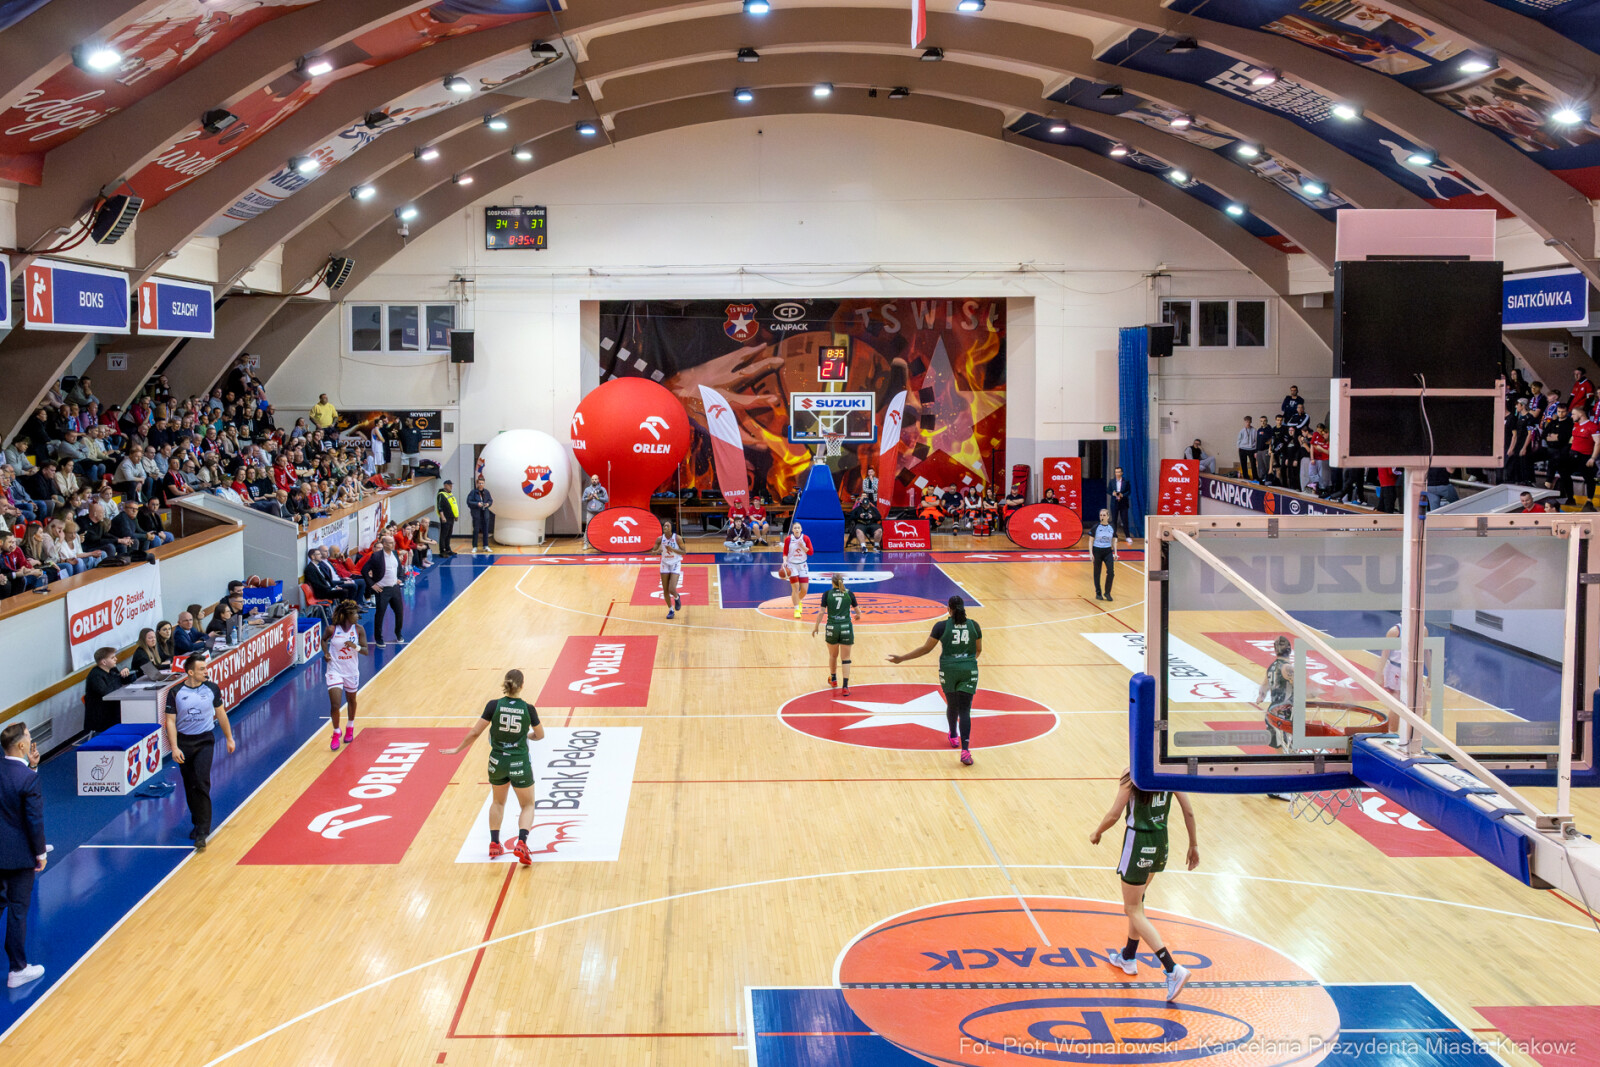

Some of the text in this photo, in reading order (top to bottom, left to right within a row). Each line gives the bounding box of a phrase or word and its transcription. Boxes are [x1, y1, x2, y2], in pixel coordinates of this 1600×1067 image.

[496, 219, 544, 229] 34 3 37
[489, 235, 496, 245] 0
[537, 235, 544, 245] 0
[79, 291, 104, 309] BOKS
[1507, 290, 1573, 309] SIATKÓWKA
[172, 301, 199, 317] SZACHY
[770, 323, 808, 331] CANPACK
[826, 349, 845, 358] 8:35
[821, 361, 845, 377] 21
[816, 399, 866, 408] SUZUKI
[633, 443, 671, 454] ORLEN
[1209, 479, 1253, 509] CANPACK
[609, 536, 641, 544] ORLEN
[1031, 532, 1062, 541] ORLEN
[126, 590, 145, 605] Basket
[835, 598, 843, 610] 7
[126, 607, 138, 620] Liga
[72, 606, 109, 639] ORLEN
[951, 630, 970, 644] 34
[208, 623, 284, 684] RZYSTWO SPORTOWE
[584, 643, 626, 675] ORLEN
[240, 658, 270, 696] KRAKÓW
[499, 713, 522, 733] 95
[348, 741, 430, 799] ORLEN
[534, 729, 601, 810] Bank Pekao
[82, 785, 121, 793] CANPACK
[921, 946, 1213, 972] CANPACK
